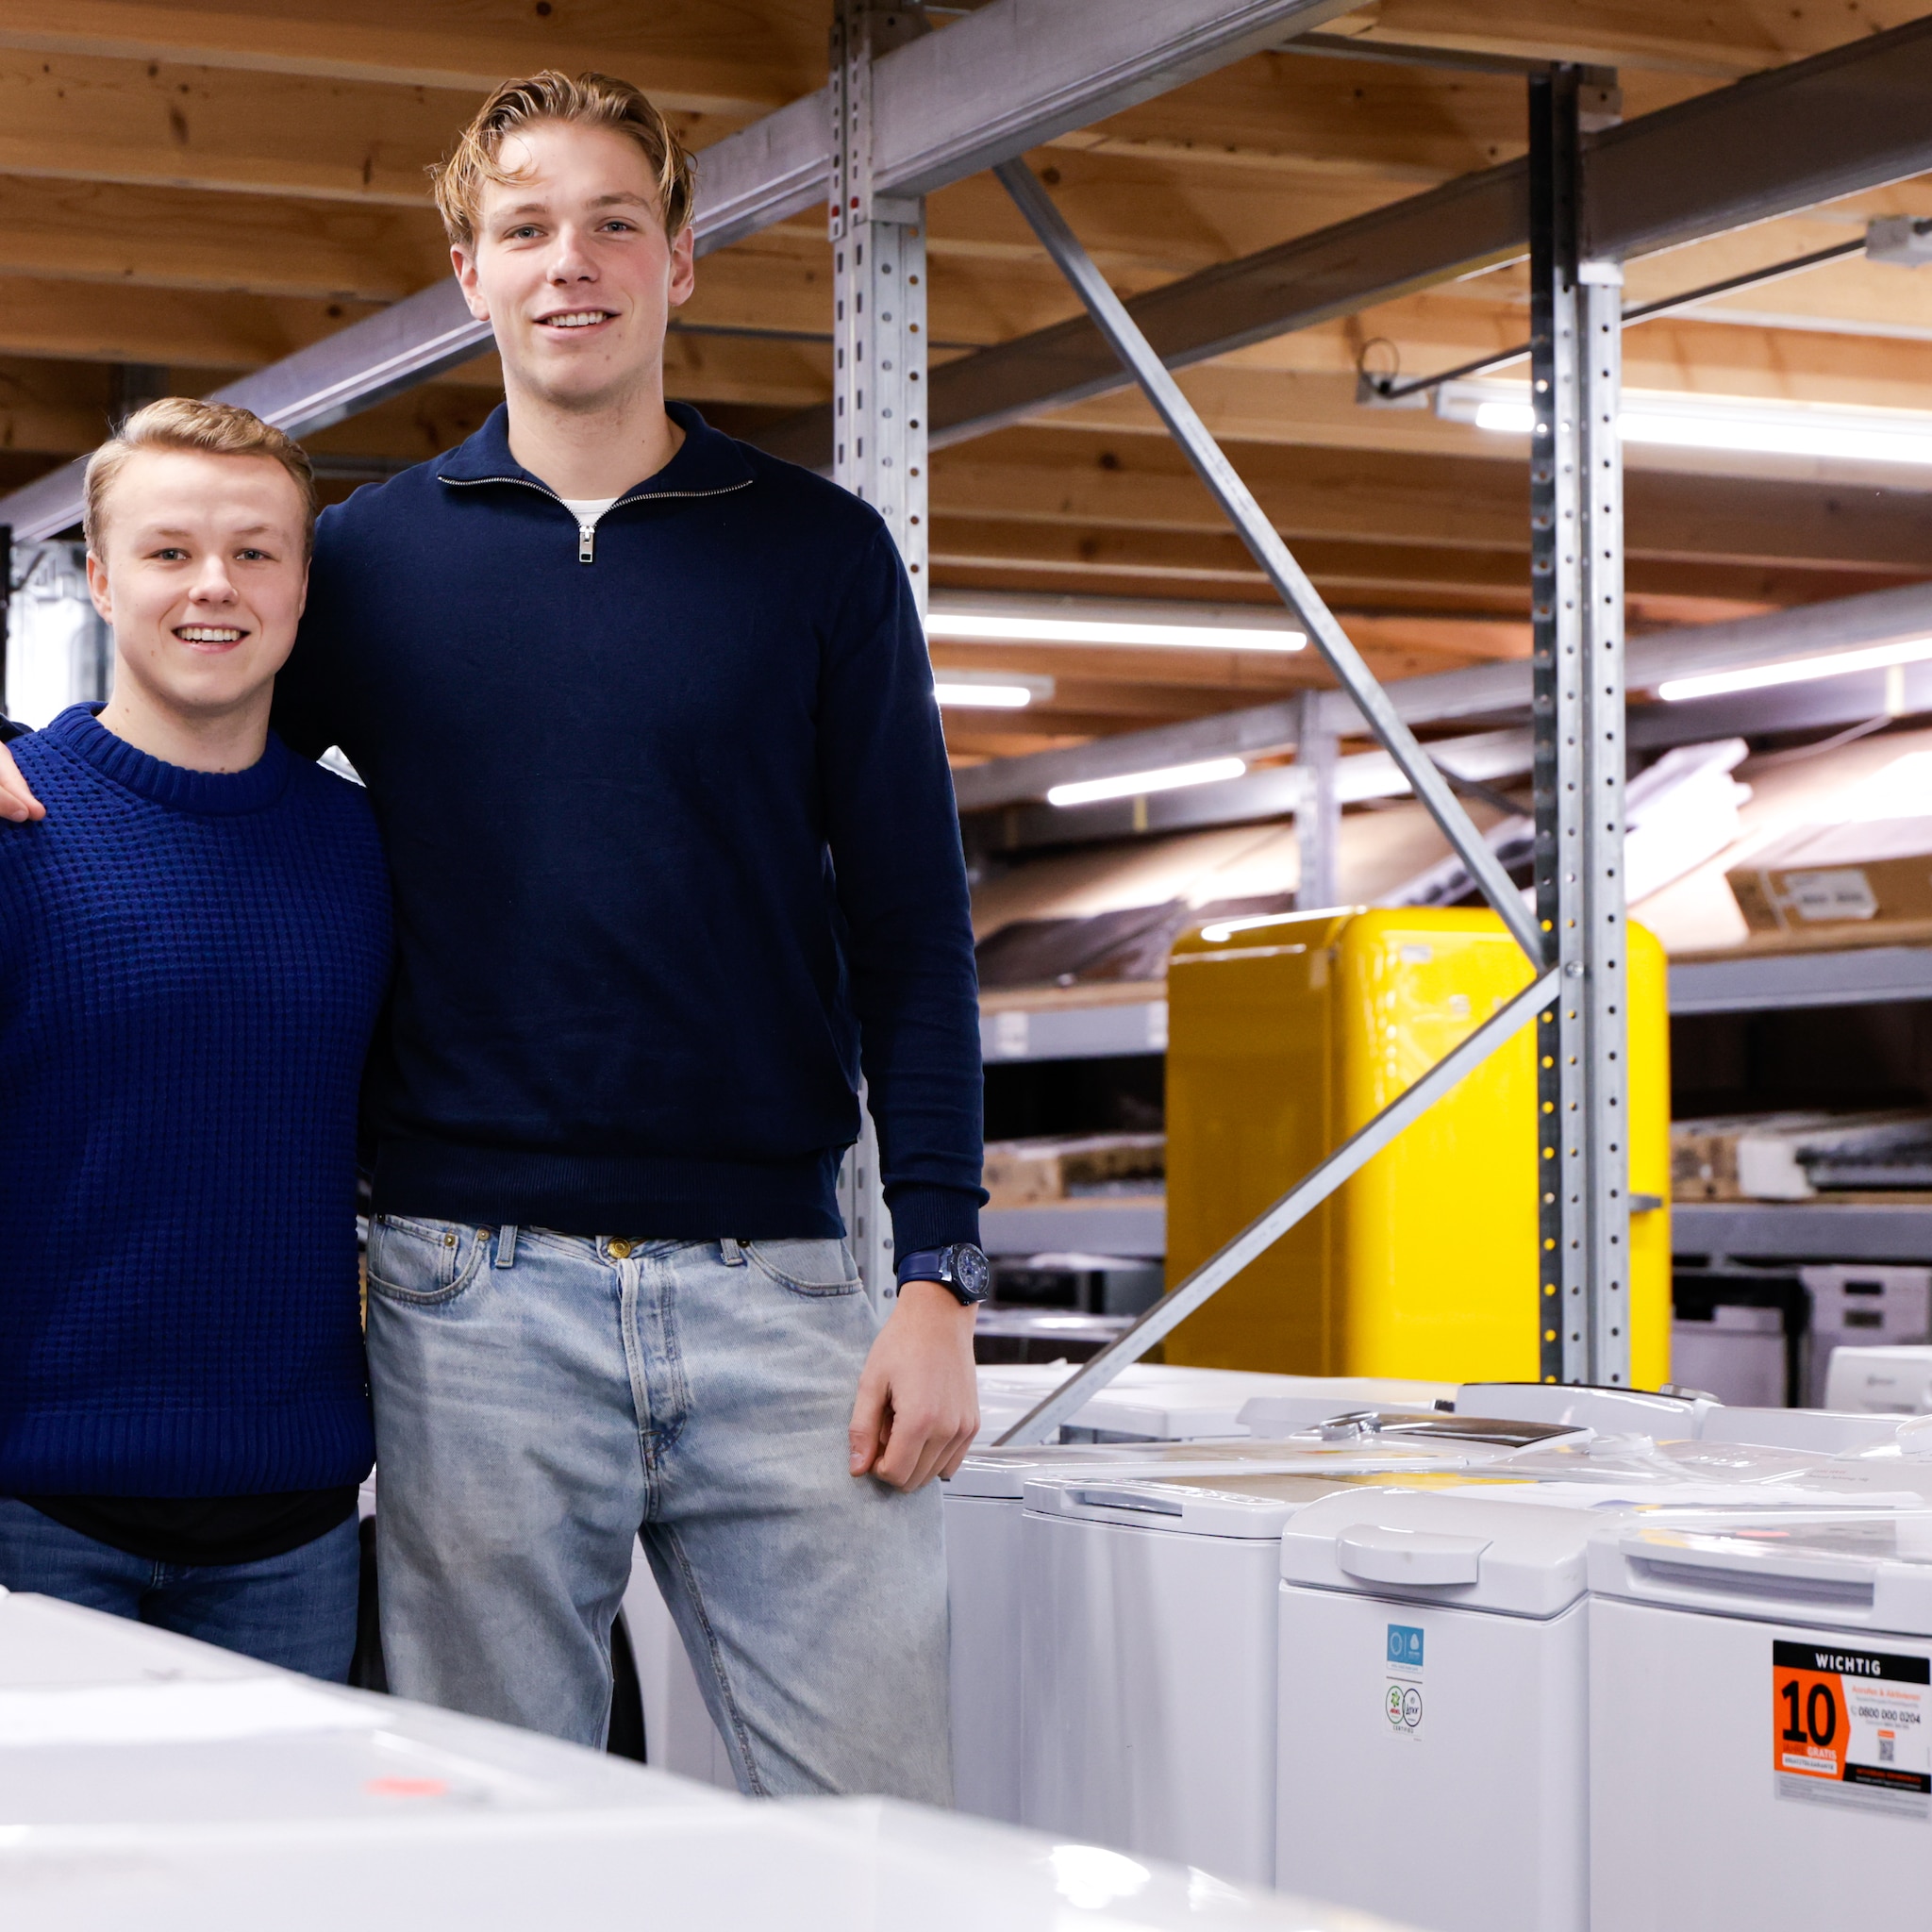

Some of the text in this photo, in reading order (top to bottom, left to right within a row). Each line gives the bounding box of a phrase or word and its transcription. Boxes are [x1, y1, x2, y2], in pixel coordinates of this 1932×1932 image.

[1815, 1653, 1881, 1675] WICHTIG
[1781, 1679, 1837, 1747] 10
[1858, 1706, 1921, 1724] 0800 000 0204
[1807, 1746, 1837, 1760] GRATIS
